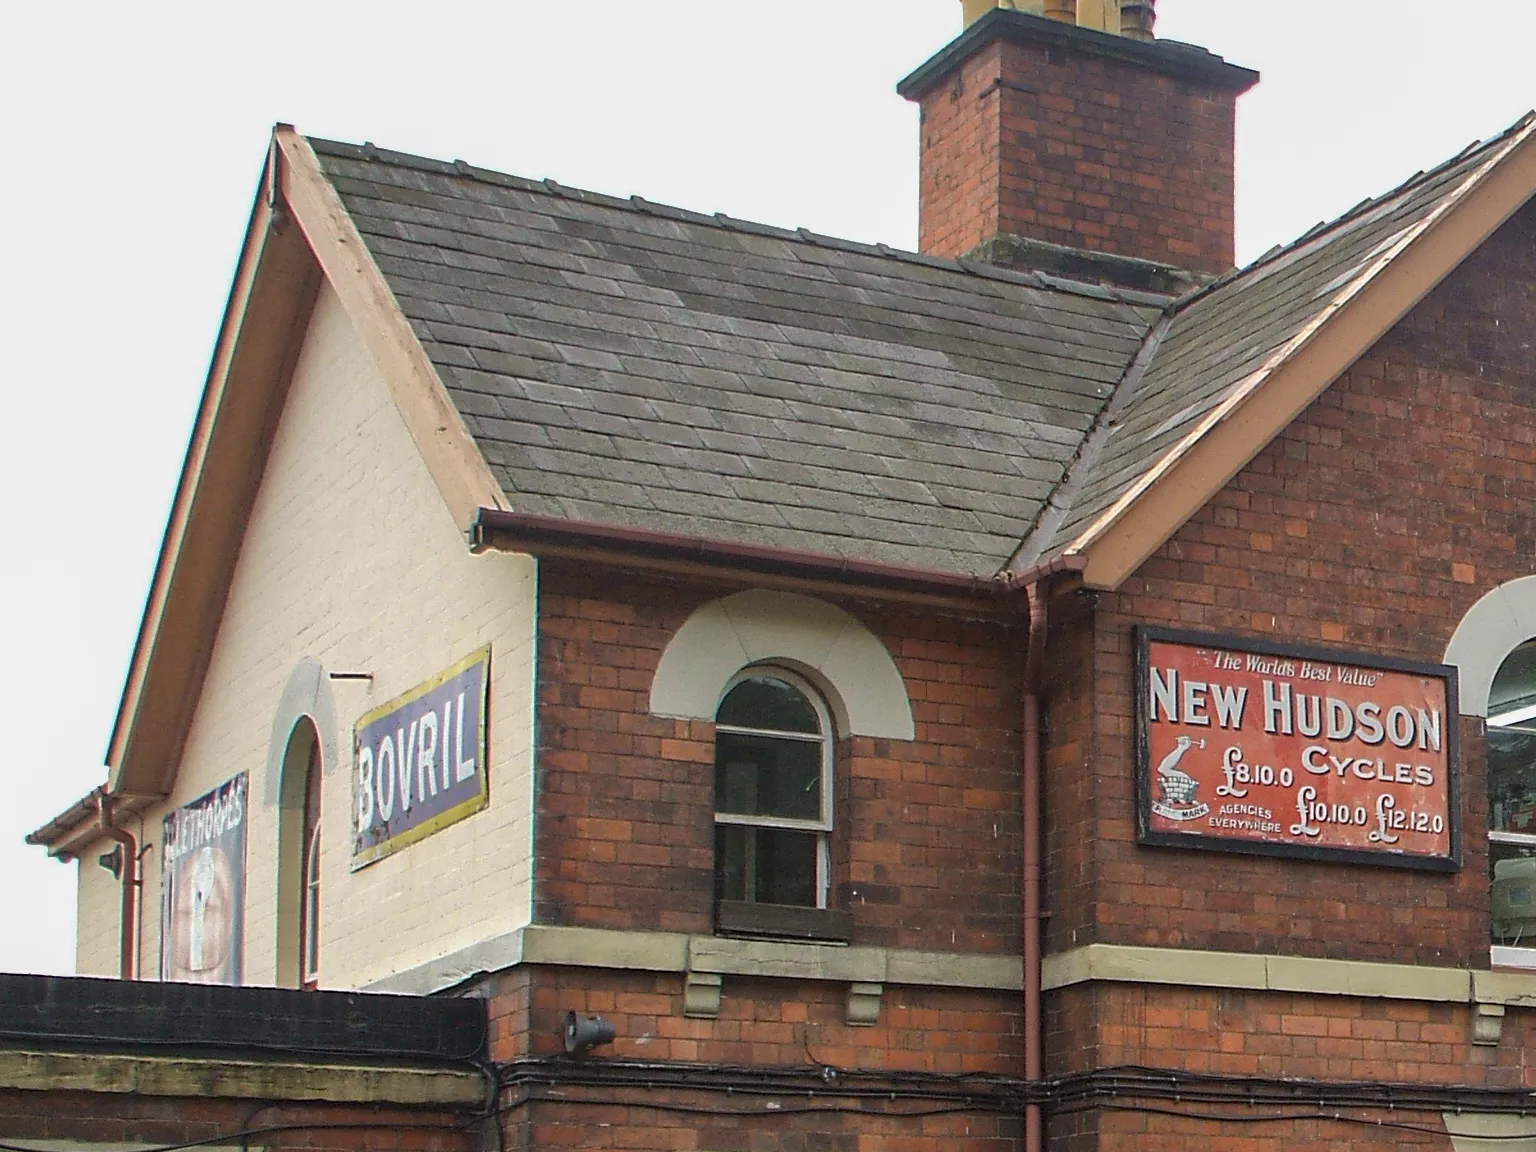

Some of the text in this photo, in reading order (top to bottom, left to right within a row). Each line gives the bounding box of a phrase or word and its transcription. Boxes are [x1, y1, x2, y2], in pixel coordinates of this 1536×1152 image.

[1246, 655, 1295, 678] World's
[1300, 665, 1332, 682] Best
[1150, 666, 1441, 751] NEW HUDSON
[357, 693, 476, 832] BOVRIL
[1216, 746, 1294, 798] £8.10.0
[1301, 745, 1434, 786] CYCLES
[1182, 806, 1206, 818] MARK
[1209, 818, 1282, 832] EVERYWHERE
[1219, 803, 1273, 819] AGENCIES
[1289, 785, 1445, 843] £10.10.0 £12.12.0
